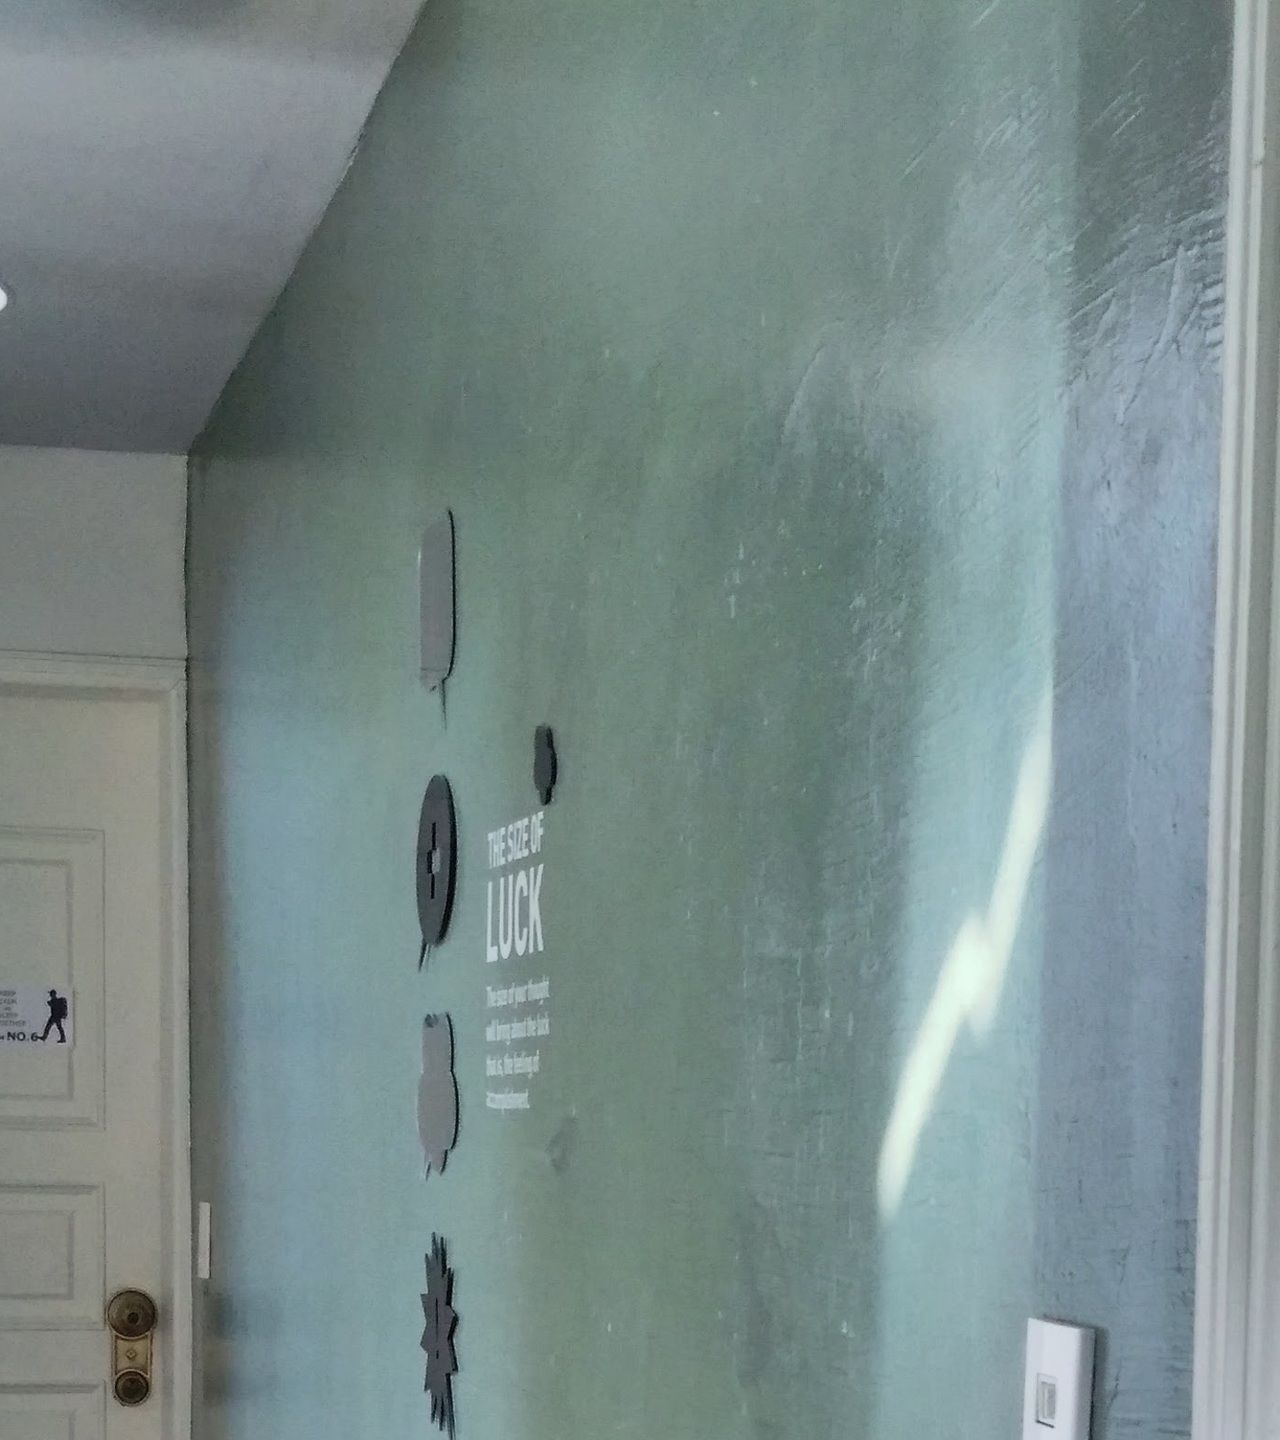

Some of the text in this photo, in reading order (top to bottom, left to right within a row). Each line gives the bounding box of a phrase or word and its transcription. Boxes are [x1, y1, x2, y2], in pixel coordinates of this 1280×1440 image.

[487, 811, 544, 869] THE SIZE OF
[486, 863, 544, 963] LUCK
